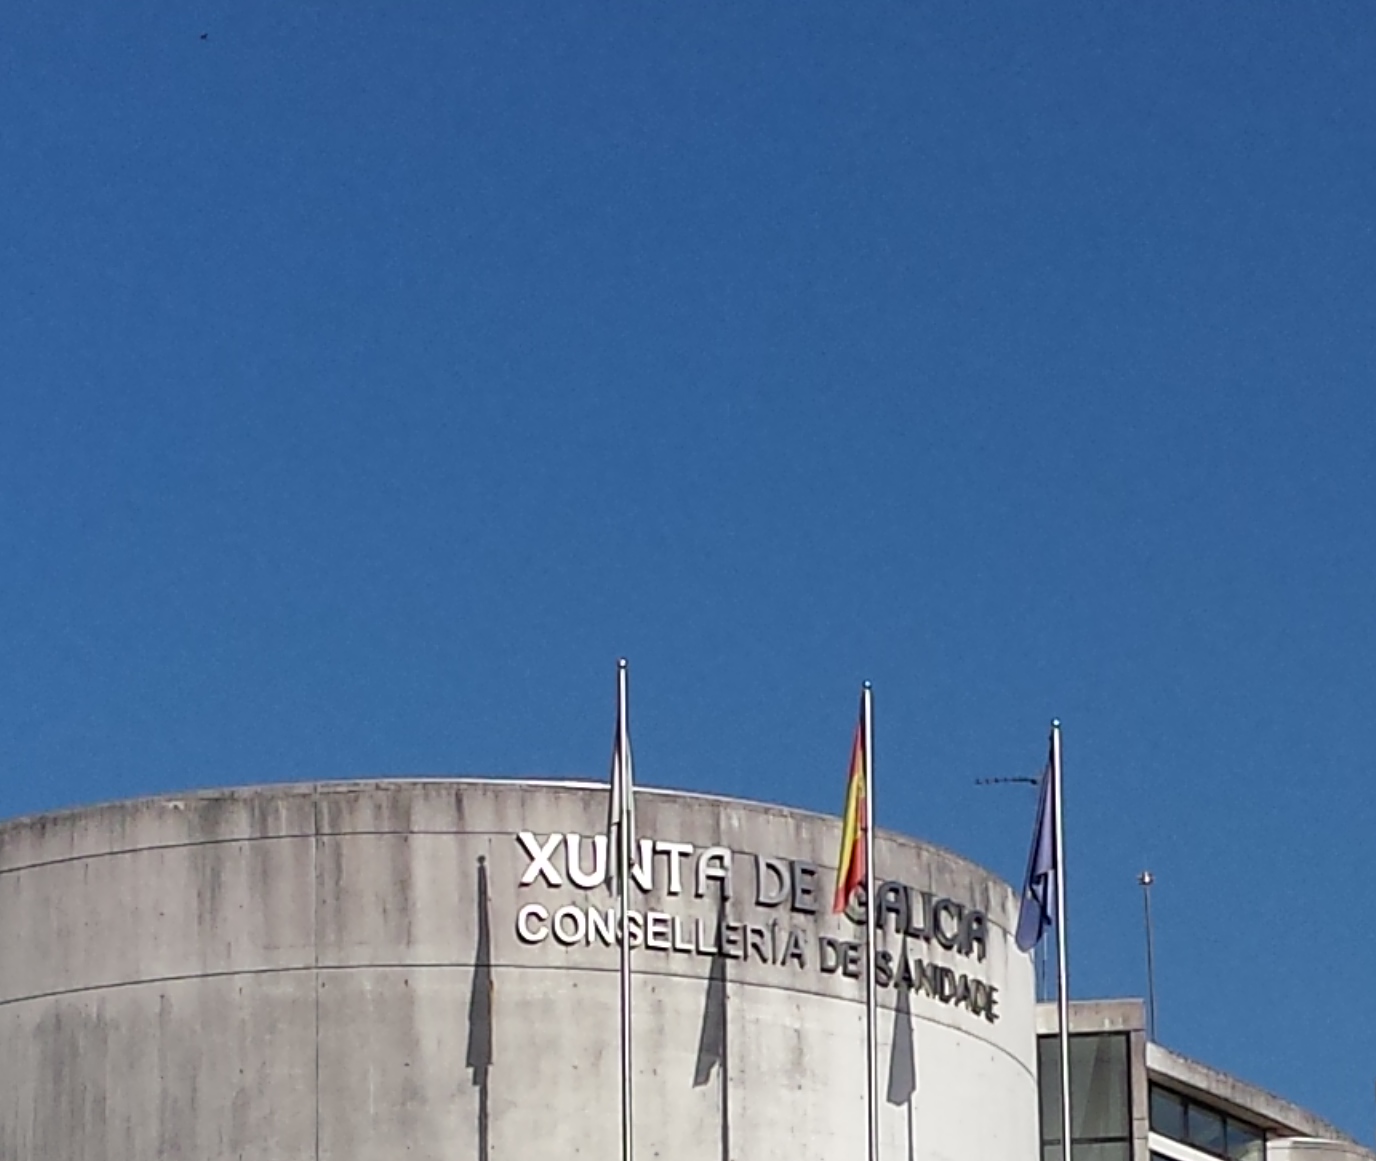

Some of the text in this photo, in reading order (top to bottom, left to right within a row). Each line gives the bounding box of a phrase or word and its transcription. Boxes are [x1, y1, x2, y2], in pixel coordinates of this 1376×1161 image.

[754, 855, 817, 915] DE
[819, 936, 861, 980] DE
[874, 950, 1000, 1024] SANIDADE
